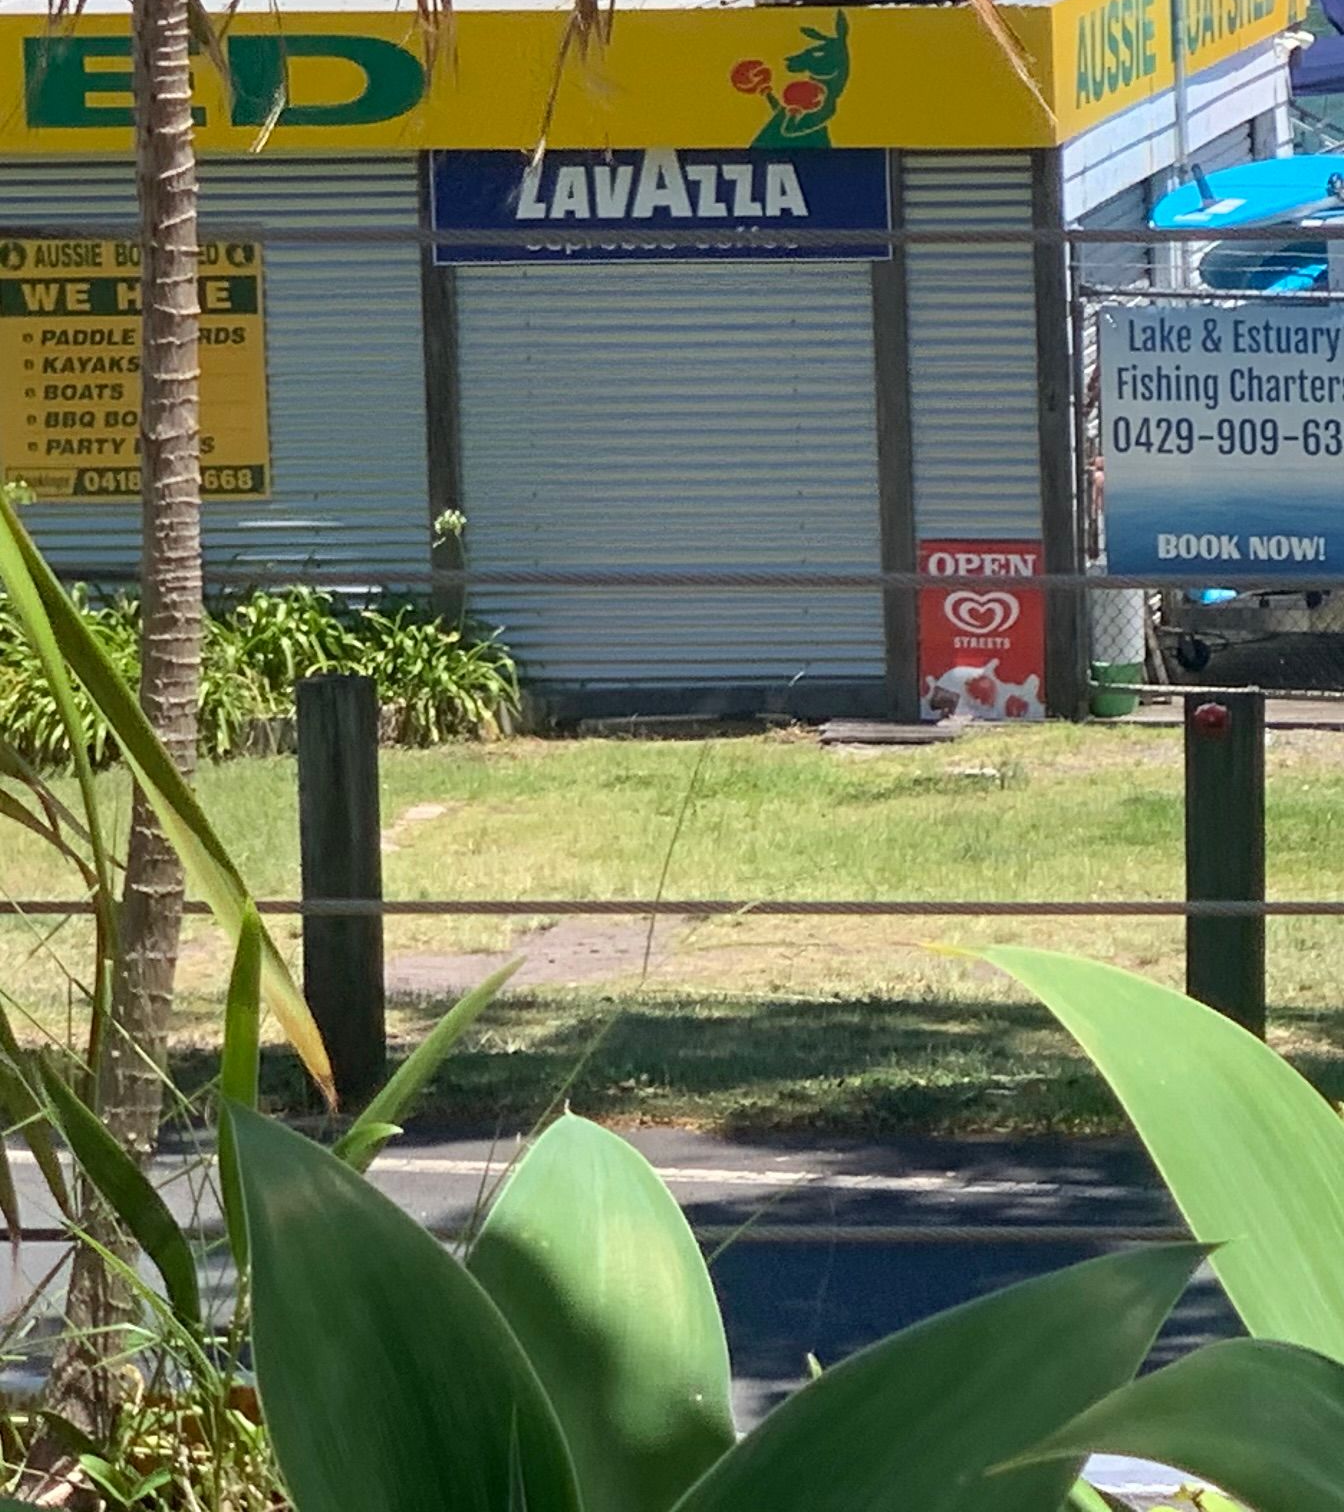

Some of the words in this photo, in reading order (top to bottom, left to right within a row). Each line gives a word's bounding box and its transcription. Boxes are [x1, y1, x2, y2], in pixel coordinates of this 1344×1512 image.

[516, 148, 809, 220] LAVAZZA
[34, 245, 103, 268] AUSSIE
[115, 242, 219, 268] BOED
[22, 283, 92, 312] WE
[117, 281, 232, 311] HE
[41, 328, 136, 346] PADDLE
[1128, 317, 1192, 354] Lake
[1201, 317, 1222, 354] &
[1233, 319, 1341, 362] Estuary
[42, 355, 141, 374] KAYAKS
[43, 383, 124, 400] BOATS
[1117, 364, 1219, 410] Fishing
[44, 410, 96, 428] BBQ
[45, 437, 124, 455] PARTY
[1157, 533, 1241, 560] BOOK
[1249, 535, 1326, 562] NOW!
[928, 552, 1036, 577] OPEN
[953, 636, 1011, 649] STREETS
